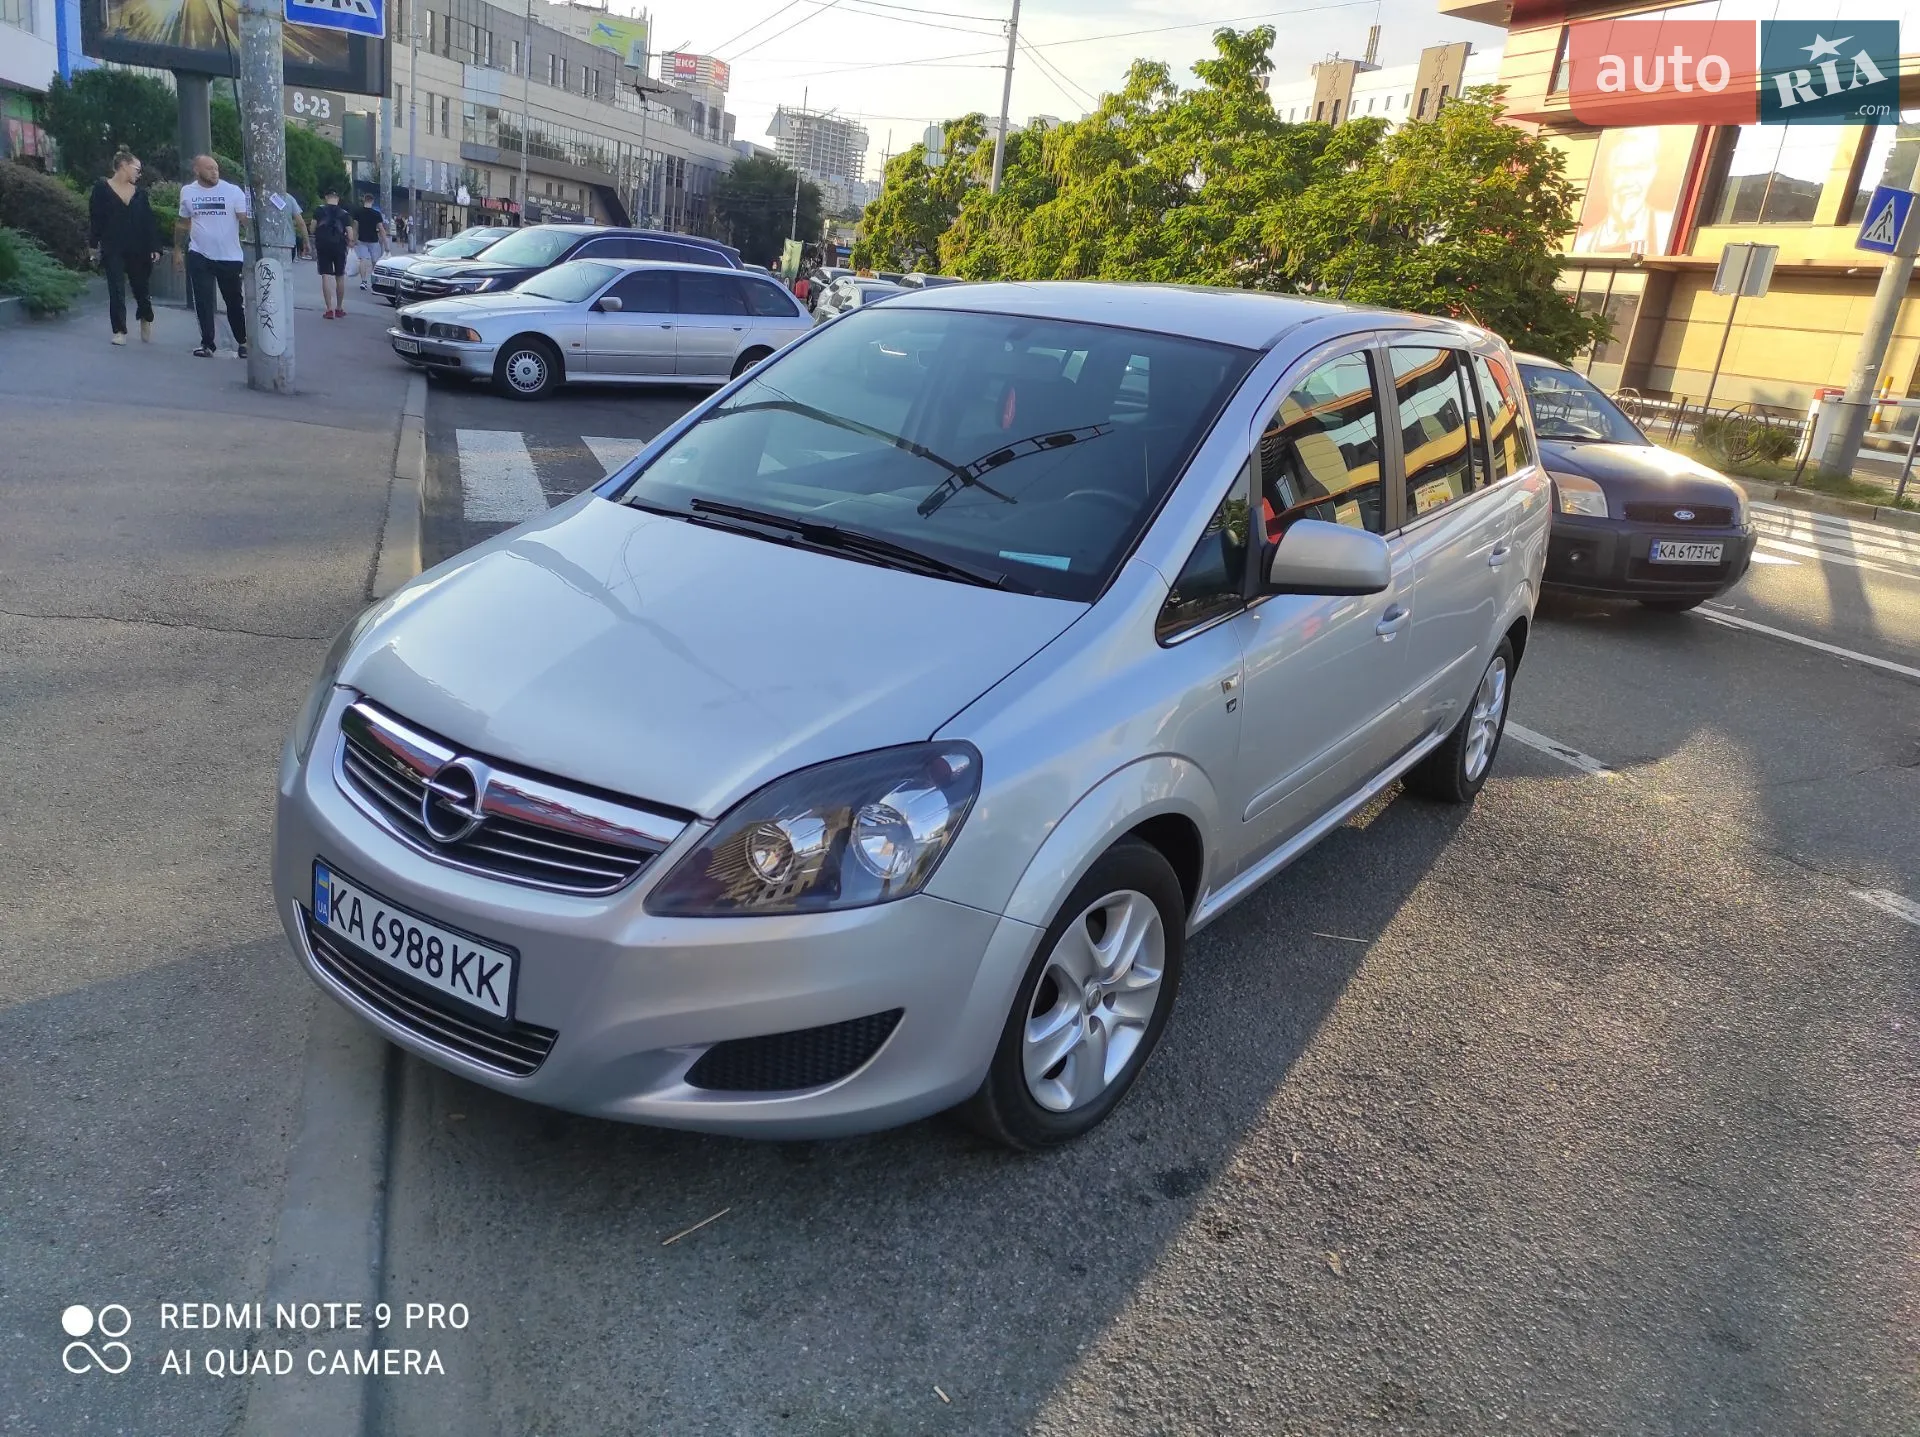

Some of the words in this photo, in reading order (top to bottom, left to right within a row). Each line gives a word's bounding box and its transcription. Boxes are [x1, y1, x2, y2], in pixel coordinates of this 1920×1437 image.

[293, 91, 331, 119] 8-23
[317, 899, 328, 917] UA
[372, 910, 444, 979] 6988
[450, 944, 505, 1007] KK
